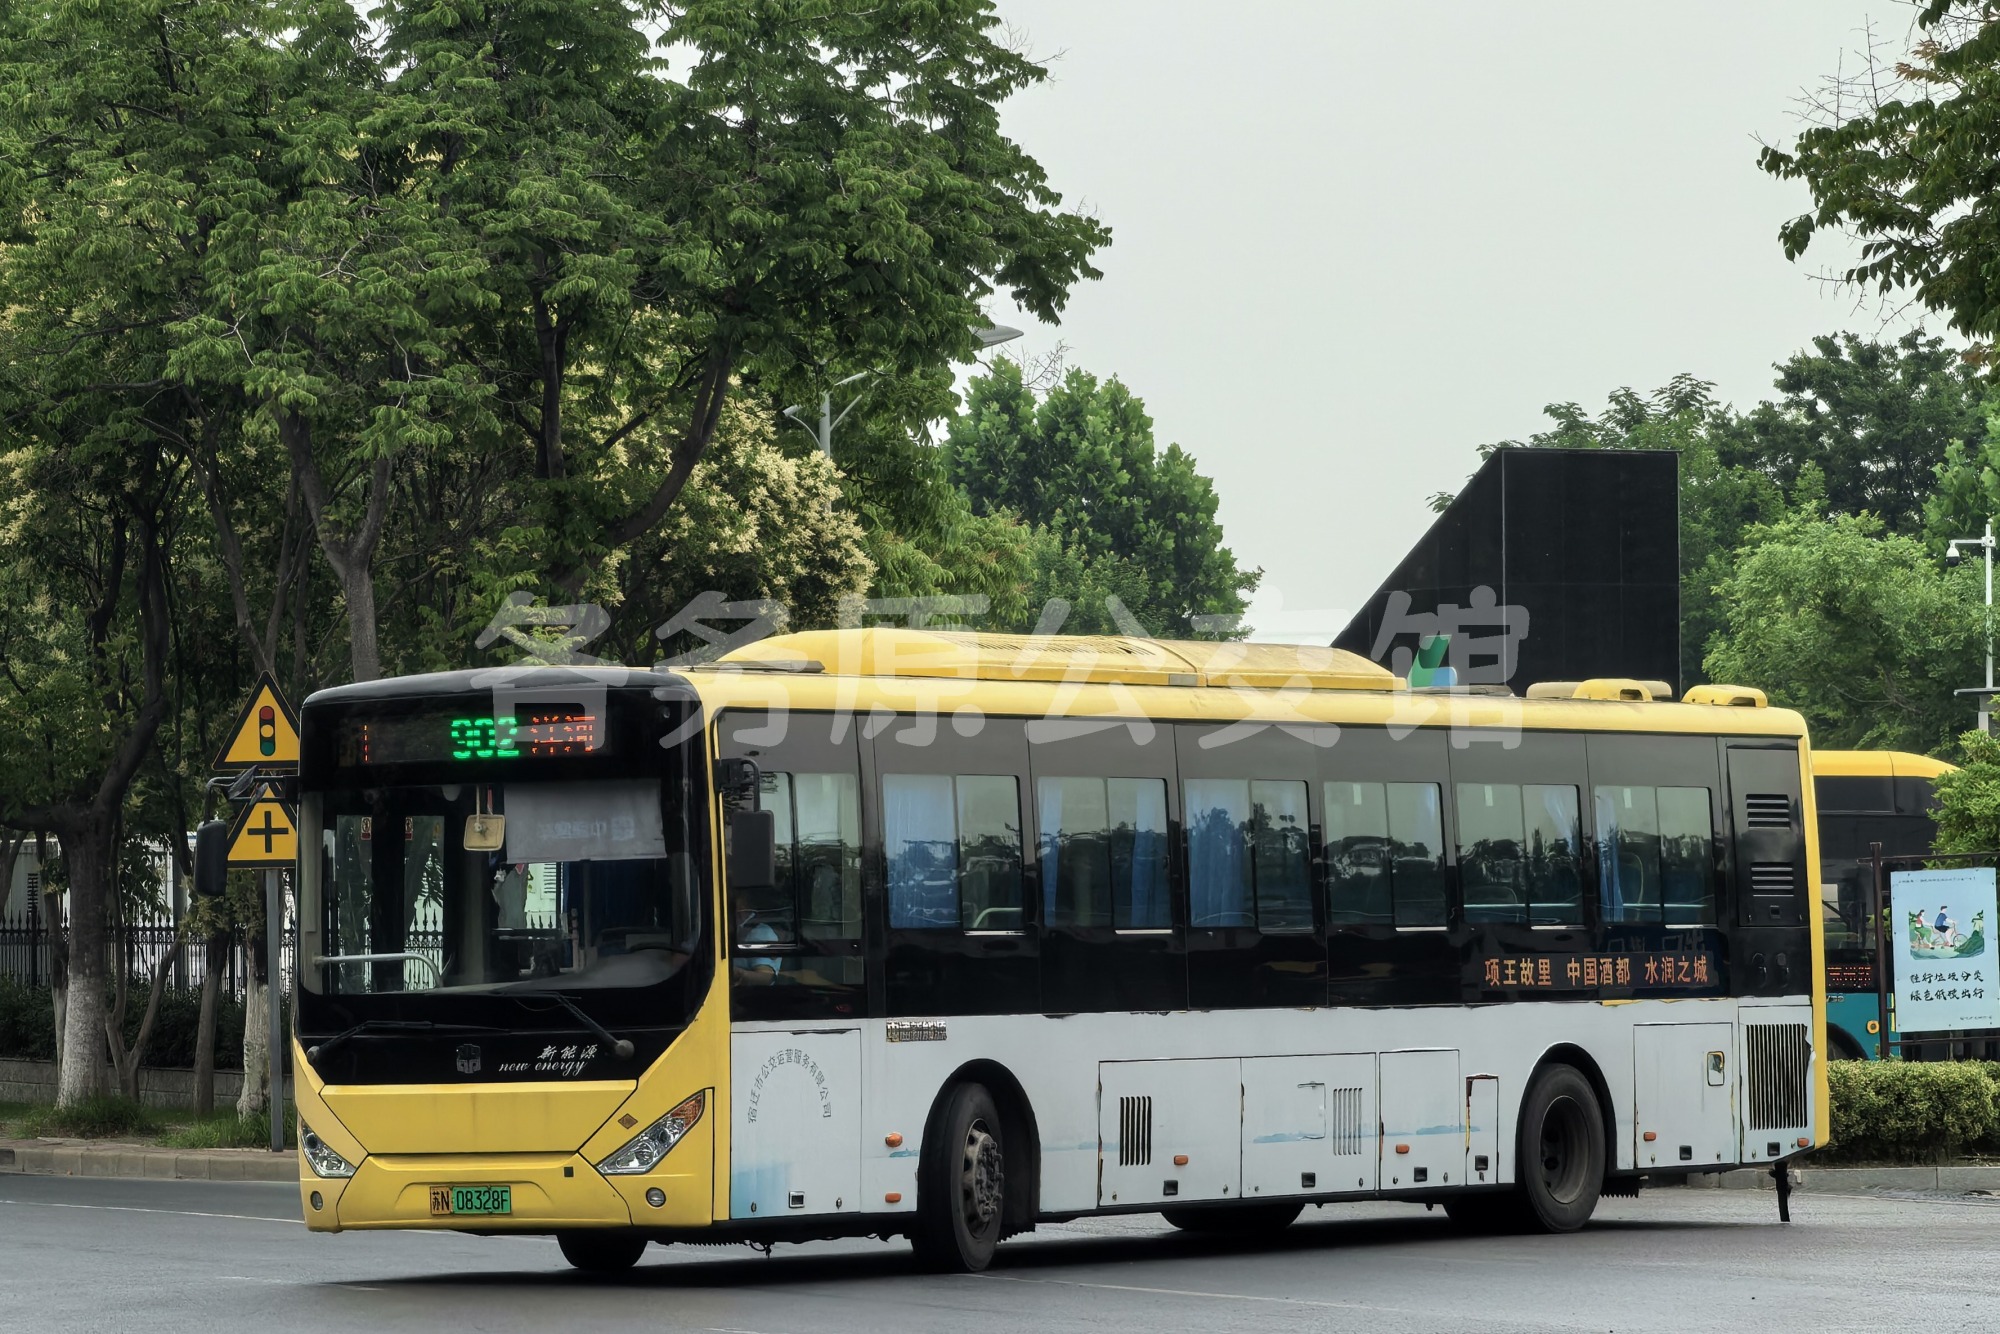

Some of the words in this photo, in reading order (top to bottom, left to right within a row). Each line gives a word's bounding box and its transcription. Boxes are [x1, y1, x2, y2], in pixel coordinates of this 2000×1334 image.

[451, 716, 519, 759] 902
[1484, 957, 1552, 986] 项王故里
[1566, 956, 1631, 986] 中国酒都
[1644, 955, 1709, 984] 水润之城
[537, 1044, 597, 1060] 新能源
[499, 1061, 531, 1072] new
[534, 1059, 588, 1077] energy
[748, 1048, 832, 1124] 宿迁市公交运营服务有限公司
